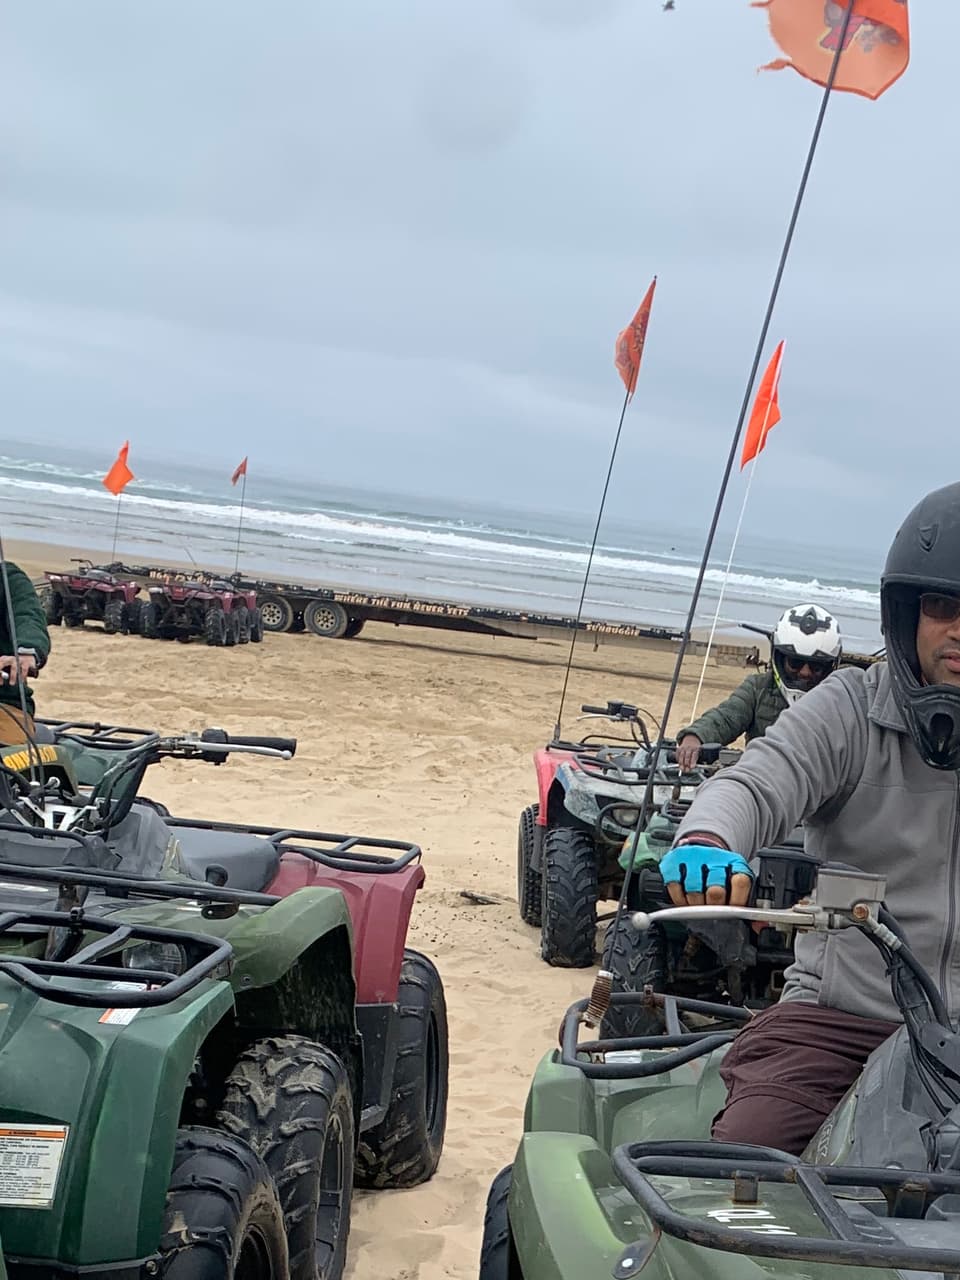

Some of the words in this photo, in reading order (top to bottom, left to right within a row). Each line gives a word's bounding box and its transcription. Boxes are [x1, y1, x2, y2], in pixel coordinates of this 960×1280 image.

[371, 598, 390, 607] THE
[391, 600, 411, 609] FUN
[413, 602, 444, 613] NEVER
